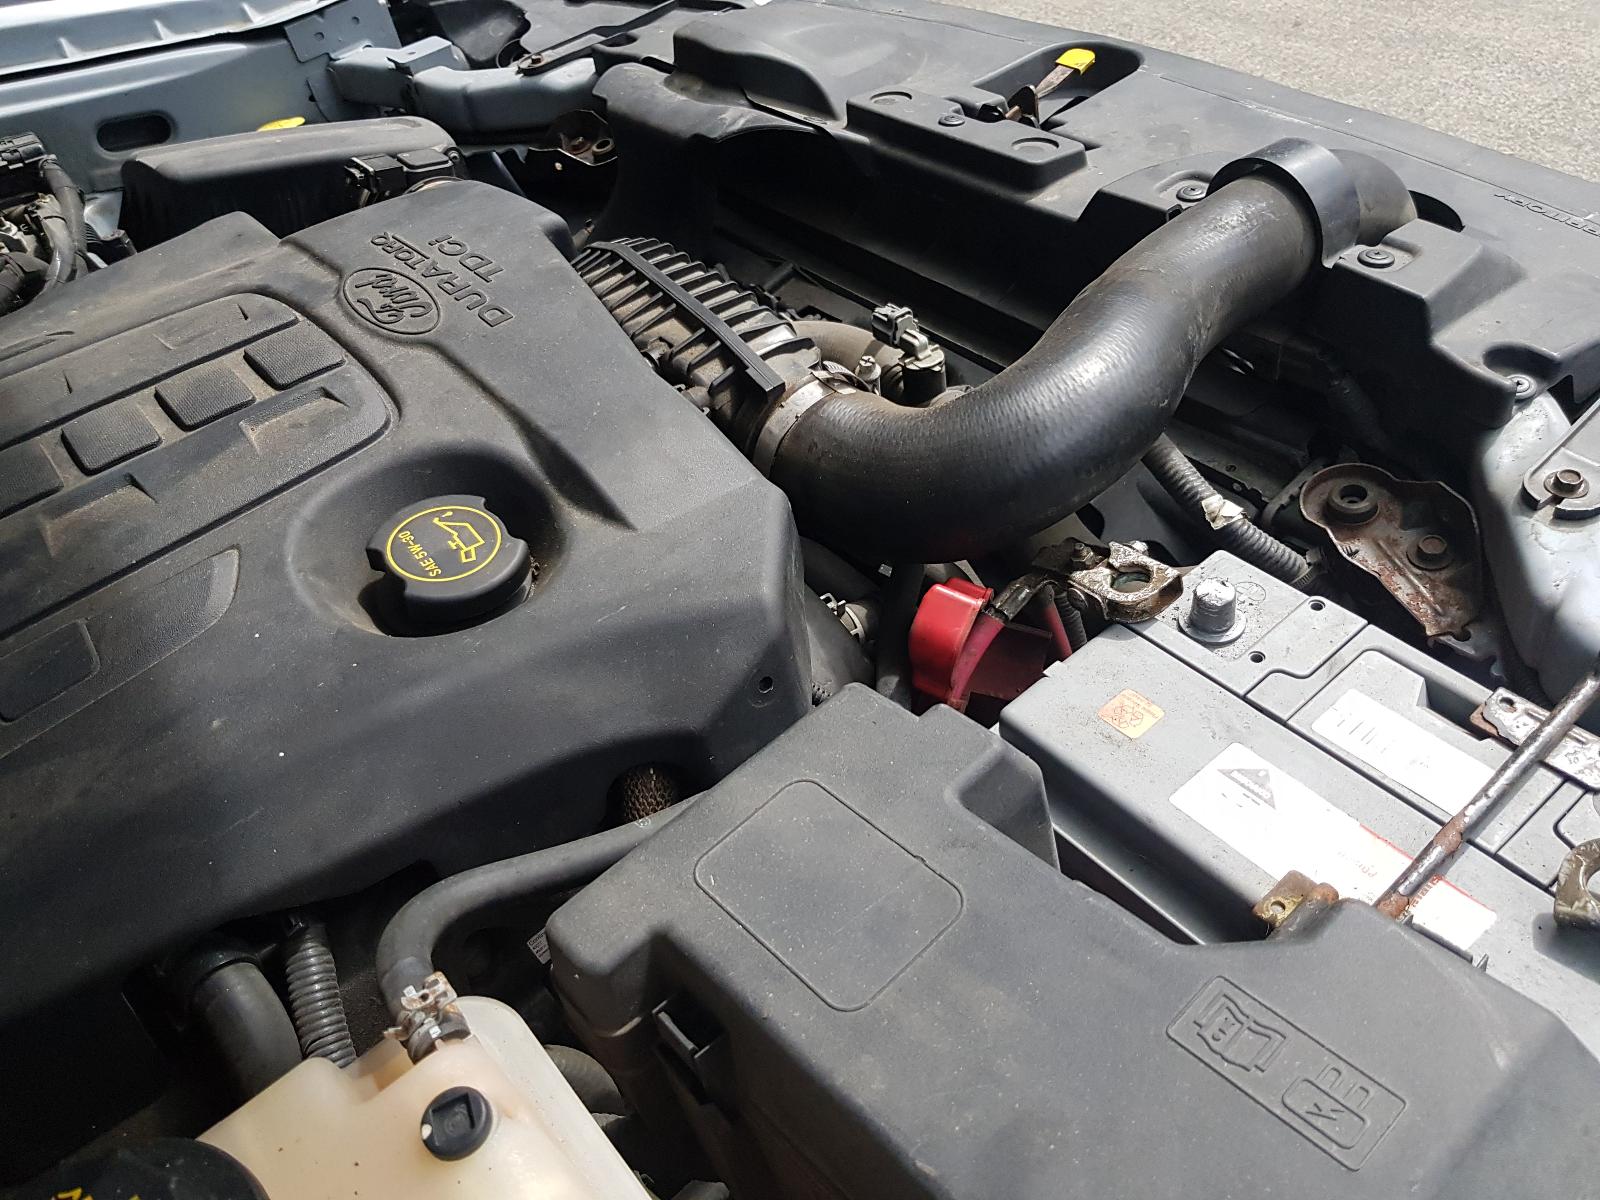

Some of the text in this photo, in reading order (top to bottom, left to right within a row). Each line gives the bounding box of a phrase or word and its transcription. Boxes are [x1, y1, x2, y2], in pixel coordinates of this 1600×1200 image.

[370, 231, 515, 328] DURATORQ
[428, 234, 505, 284] TDCi
[355, 273, 434, 324] Ford
[399, 531, 441, 576] SAE 5W-30
